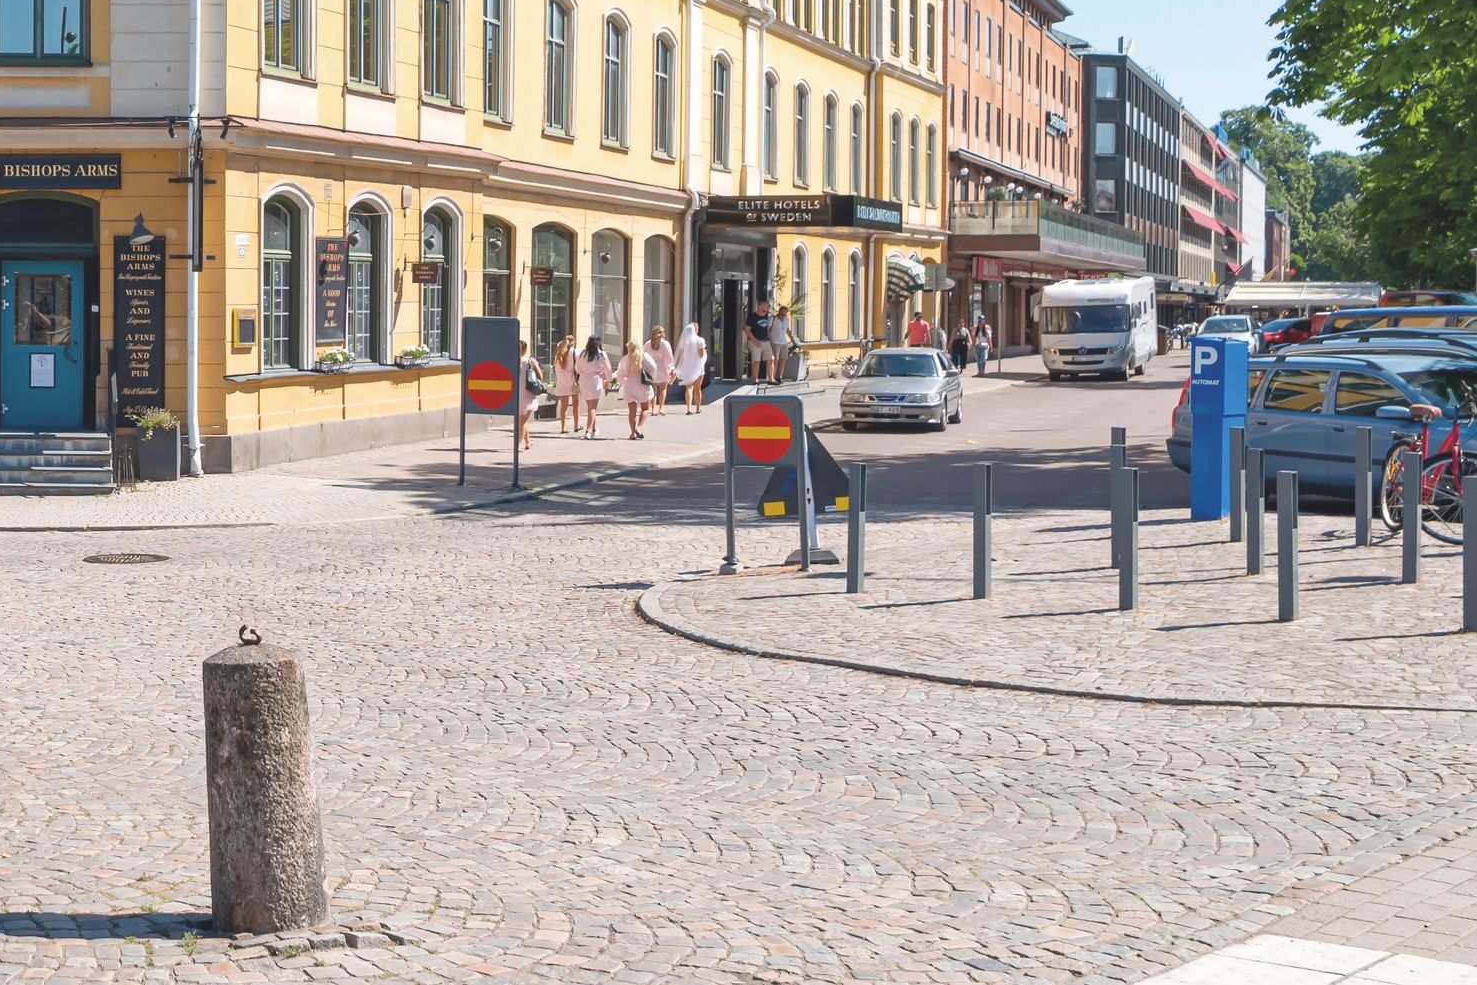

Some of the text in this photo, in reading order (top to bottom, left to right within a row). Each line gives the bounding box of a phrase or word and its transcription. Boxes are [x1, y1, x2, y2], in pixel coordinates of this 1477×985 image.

[4, 165, 70, 177] BISHOPS
[75, 165, 118, 177] ARMS
[738, 200, 820, 210] ELITE HOTELS
[761, 213, 812, 222] SWEDEN
[127, 263, 155, 271] ARMS
[1194, 346, 1218, 375] P
